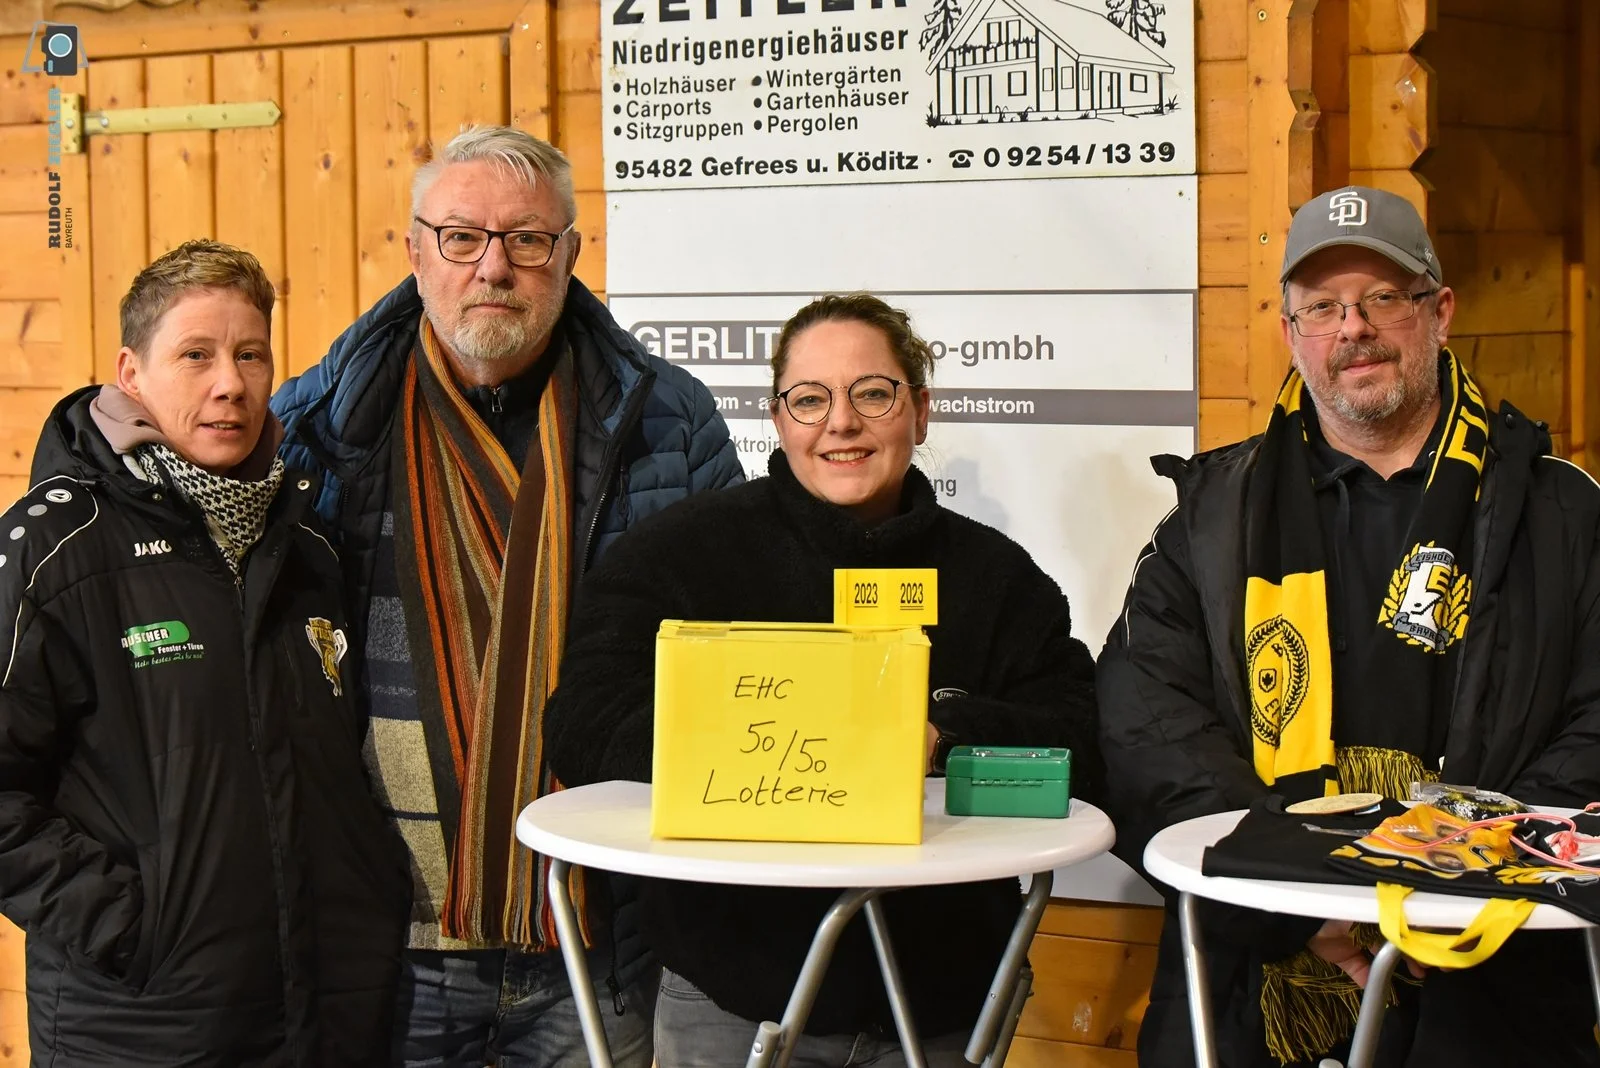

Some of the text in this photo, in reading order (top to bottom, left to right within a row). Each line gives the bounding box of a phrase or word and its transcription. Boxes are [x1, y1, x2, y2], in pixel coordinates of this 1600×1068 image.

[612, 26, 909, 65] Niedrigenergiehäuser
[626, 75, 737, 97] Holzhäuser
[766, 65, 902, 89] Wintergärten
[626, 98, 712, 121] Carports
[766, 88, 909, 111] Gartenhäuser
[626, 121, 744, 143] Sitzgruppen
[767, 112, 859, 136] Pergolen
[615, 158, 693, 179] 95482
[701, 155, 798, 177] Gefrees
[806, 157, 828, 174] u.
[837, 150, 919, 173] Köditz
[634, 326, 1056, 367] GERLIT o-gmbh
[929, 396, 1035, 414] wachstrom
[854, 582, 924, 605] 2023 2023
[121, 628, 169, 648] AUSCHER
[734, 675, 794, 700] EHC
[702, 769, 848, 806] Lotterie
